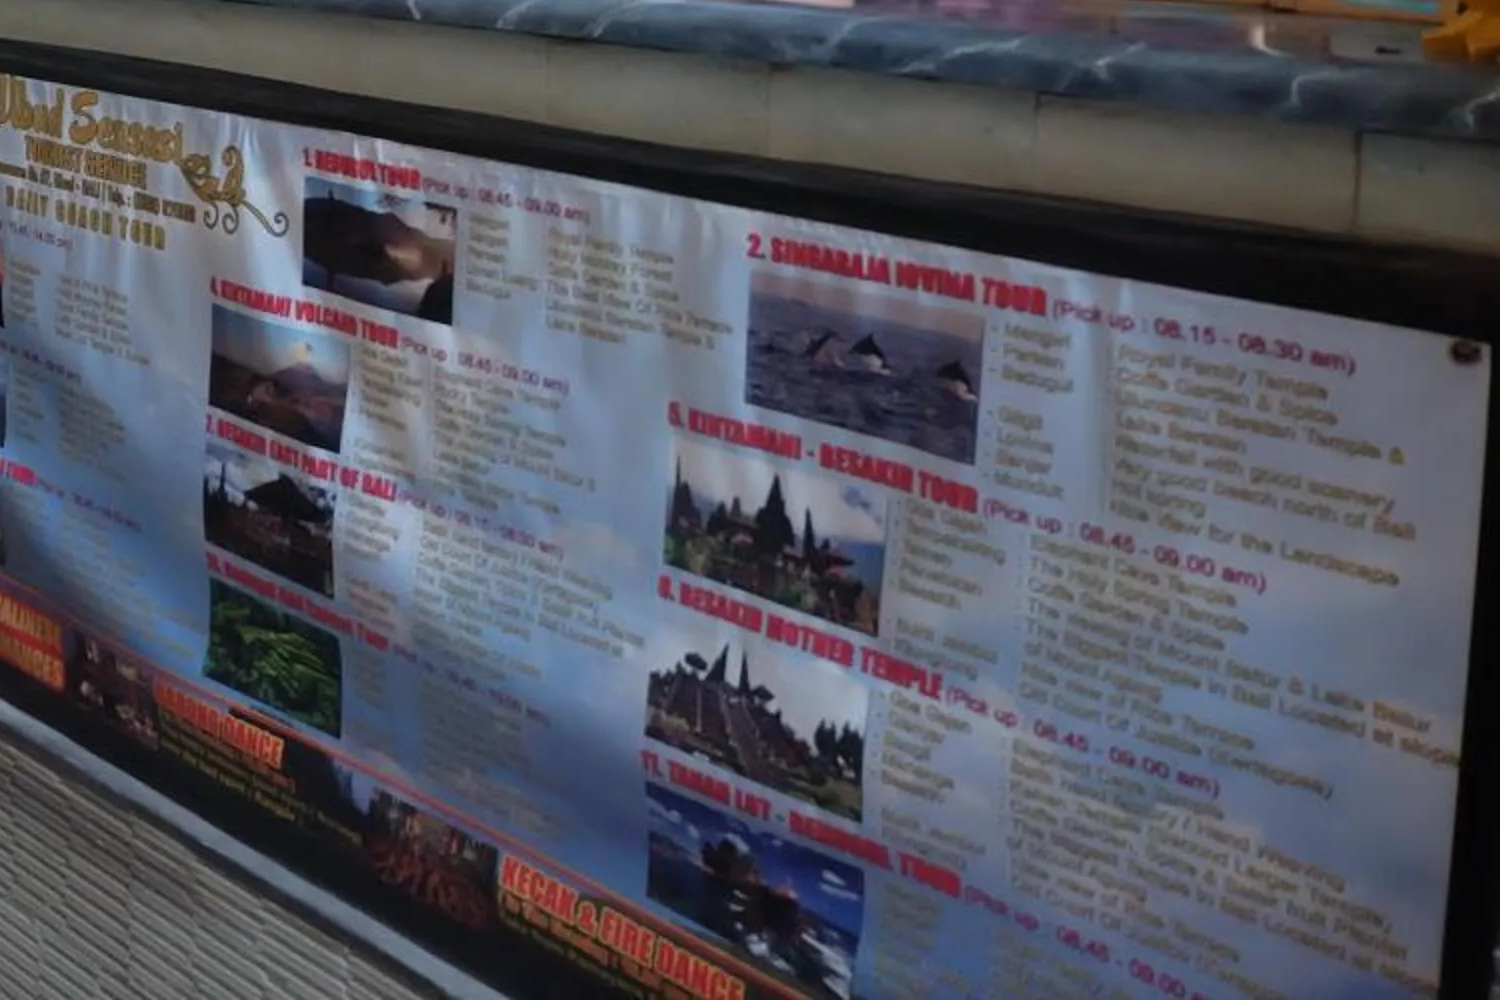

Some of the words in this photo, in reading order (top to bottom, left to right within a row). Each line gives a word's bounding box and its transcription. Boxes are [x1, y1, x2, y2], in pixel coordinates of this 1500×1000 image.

[375, 161, 420, 191] TOUR
[118, 216, 165, 249] TOUR
[745, 232, 768, 261] 2.
[979, 275, 1047, 317] TOUR
[1052, 296, 1101, 328] (Pick
[1103, 311, 1134, 336] up
[1152, 315, 1216, 349] 08.15
[1236, 331, 1303, 366] 08.30
[1309, 346, 1358, 380] am)
[360, 316, 399, 349] TOUR
[1254, 370, 1328, 406] Temple
[339, 460, 360, 492] OF
[918, 469, 977, 513] TOUR
[982, 493, 1031, 530] (Pick
[1036, 512, 1062, 540] up
[1155, 540, 1215, 579] 09.00
[1222, 560, 1267, 597] am)
[1027, 595, 1060, 625] The
[1029, 555, 1062, 583] The
[1176, 598, 1249, 639] Temple
[1166, 572, 1237, 611] Temple
[1026, 615, 1058, 645] The
[224, 710, 284, 770] DANCE
[860, 645, 942, 702] TEMPLE
[946, 683, 989, 721] (Pick
[993, 704, 1017, 732] up
[1108, 742, 1169, 784] 09.00
[1175, 765, 1220, 805] am)
[898, 848, 962, 903] TOUR
[502, 856, 578, 926] KECAK
[578, 902, 597, 934] &
[600, 907, 654, 967] FIRE
[656, 938, 744, 1000] DANCE
